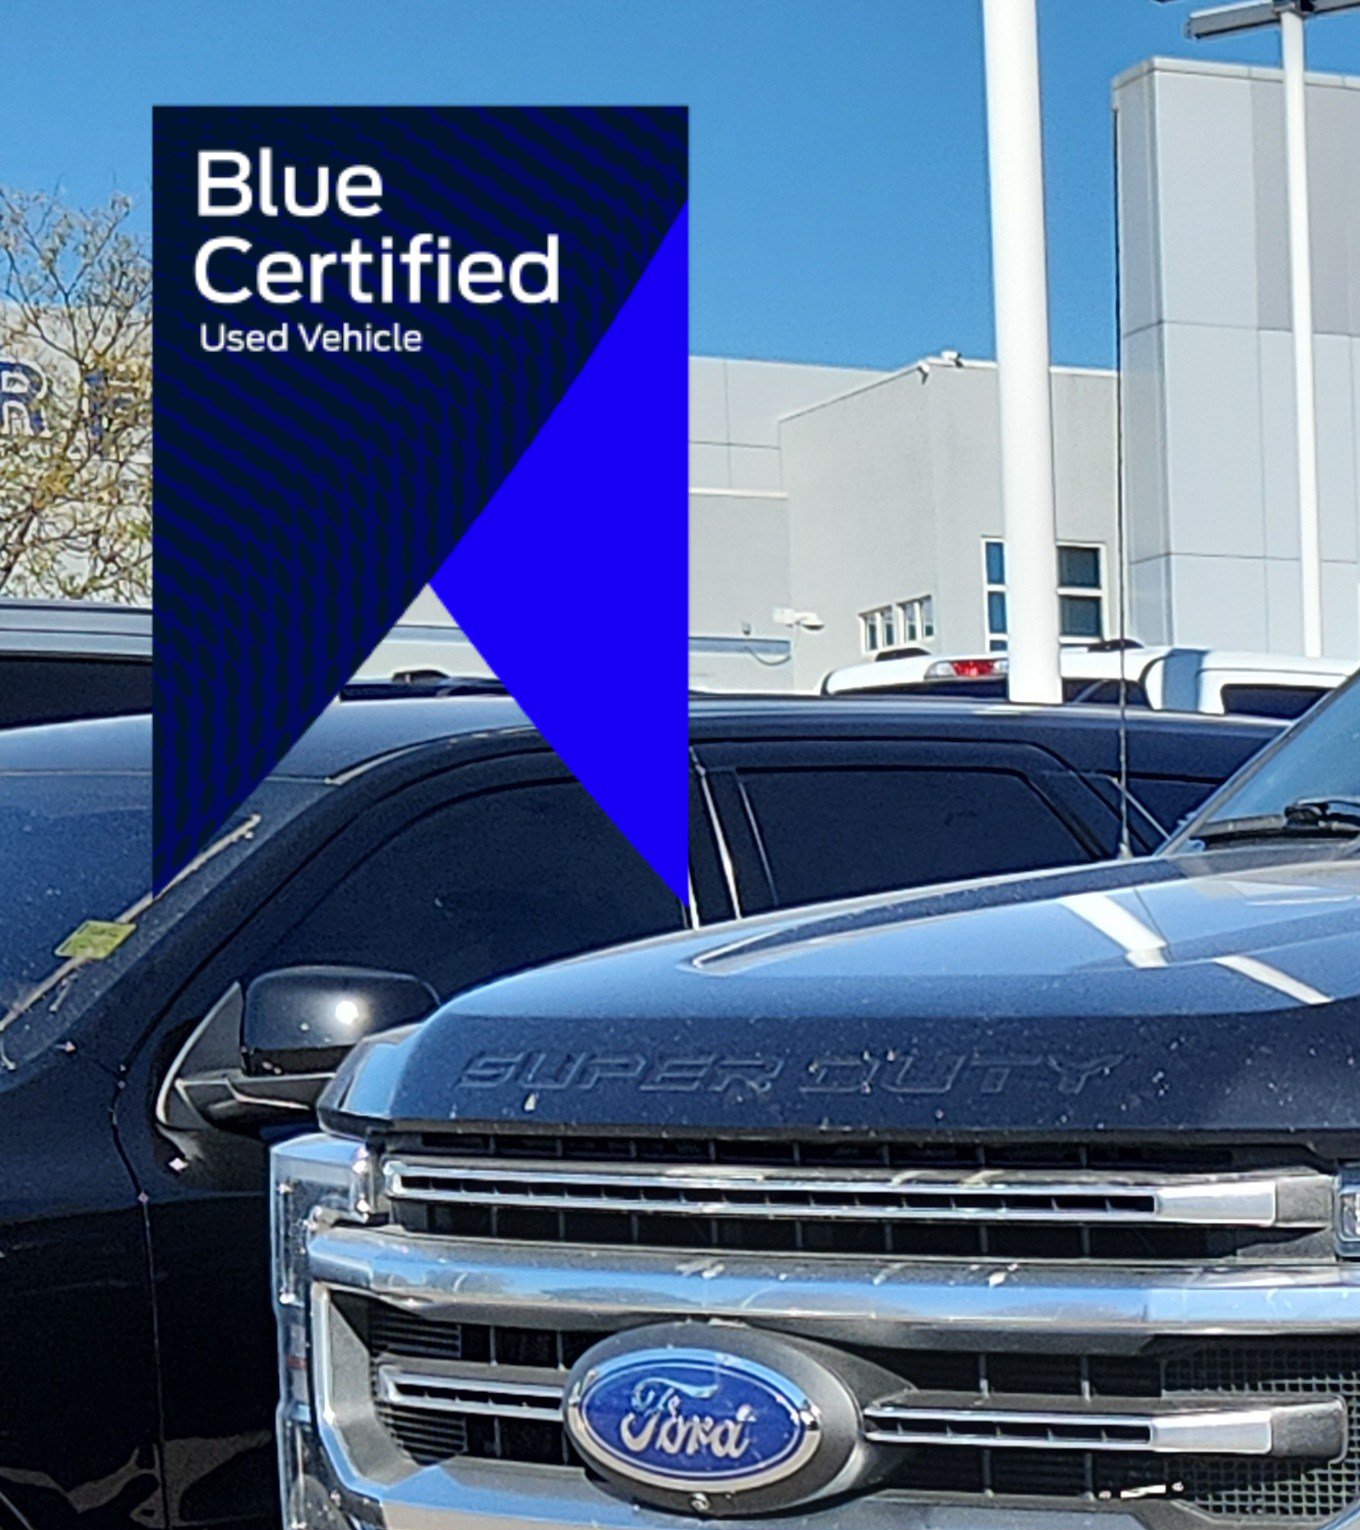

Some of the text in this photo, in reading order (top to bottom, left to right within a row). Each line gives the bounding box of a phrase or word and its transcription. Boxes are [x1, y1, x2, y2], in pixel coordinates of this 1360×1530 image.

[457, 1052, 1125, 1094] SUPER DUTY
[621, 1376, 752, 1458] Ford
